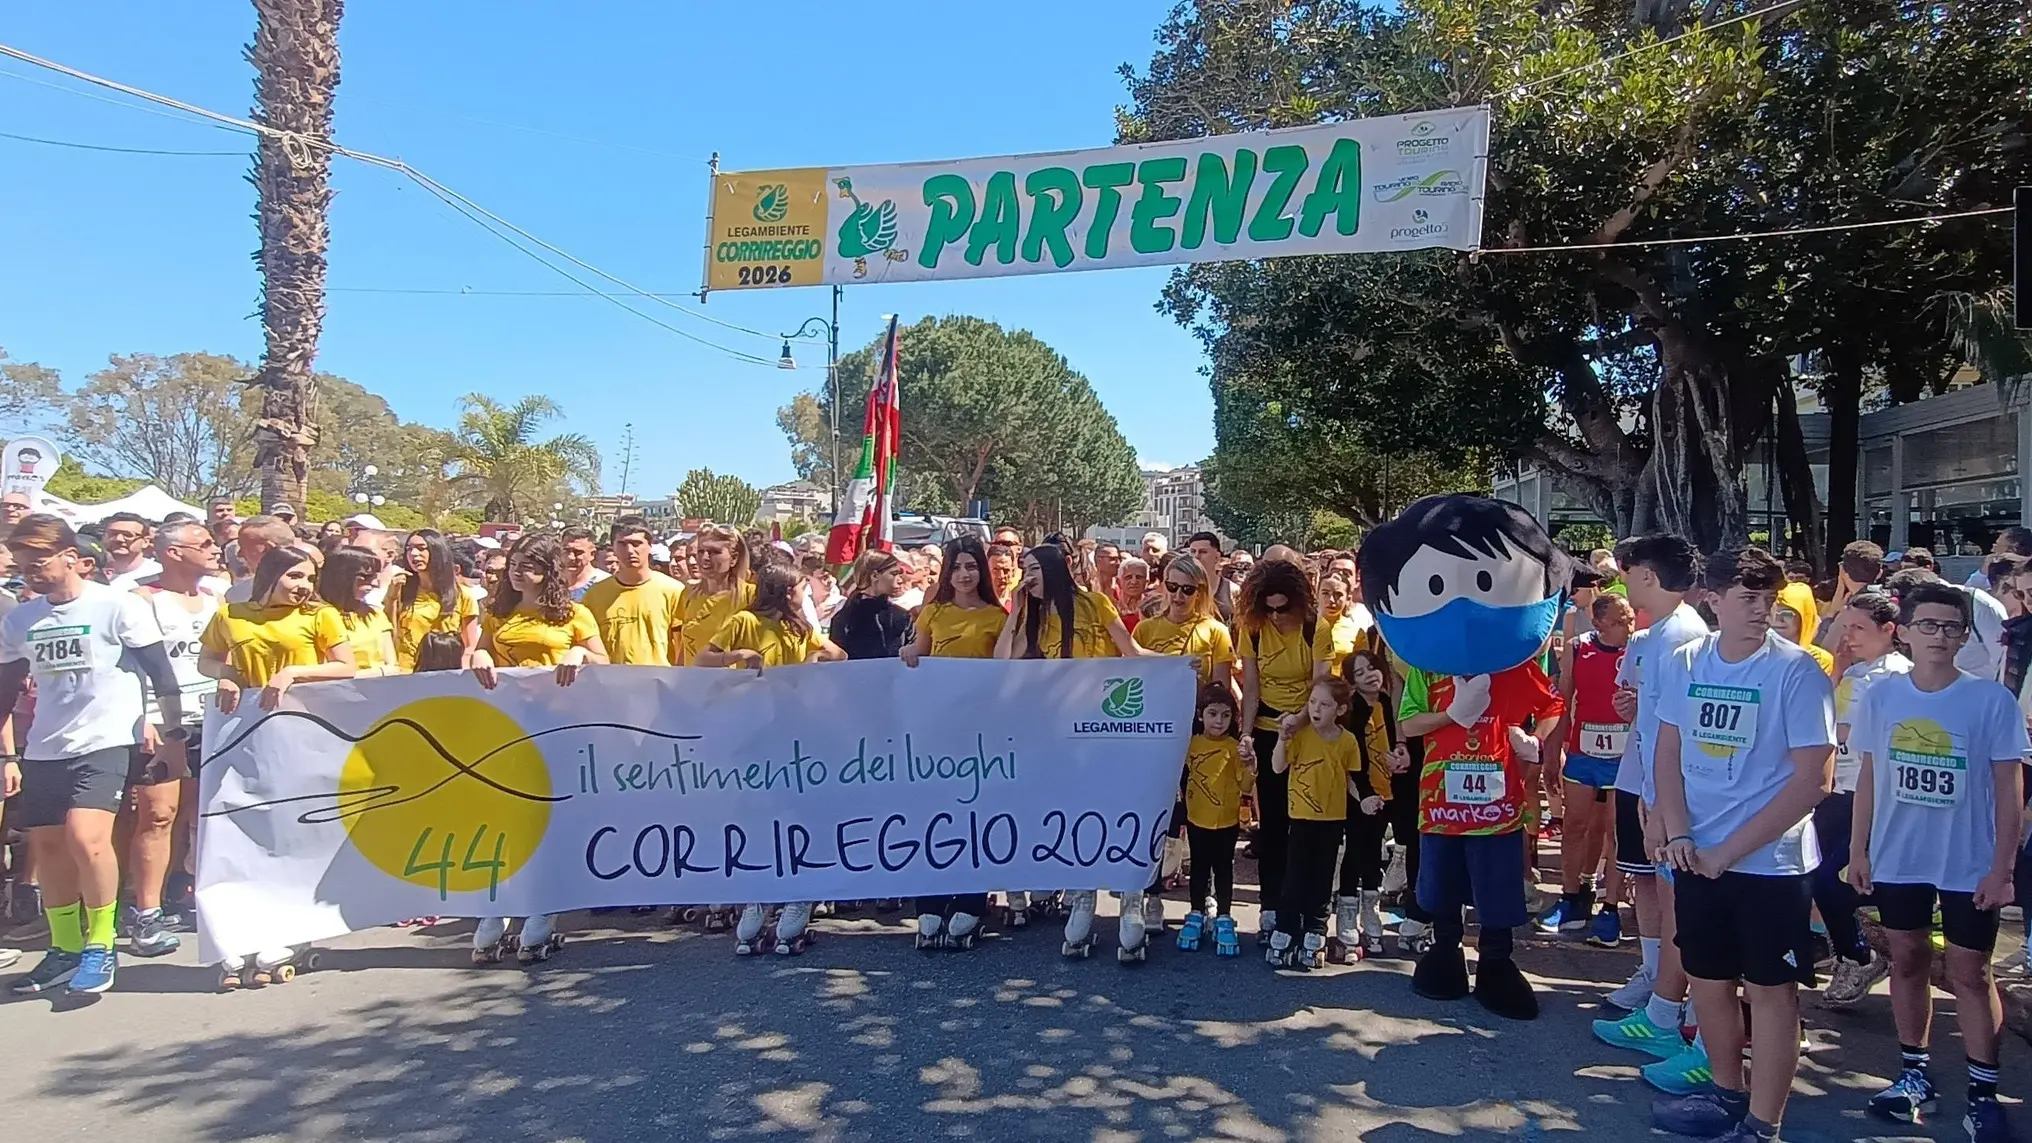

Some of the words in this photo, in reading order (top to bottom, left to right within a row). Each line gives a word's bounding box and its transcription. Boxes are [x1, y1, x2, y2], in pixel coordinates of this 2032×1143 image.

[1396, 138, 1449, 148] PROGETTO
[918, 138, 1362, 268] PARTENZA
[727, 225, 810, 238] LEGAMBIENTE
[716, 238, 822, 262] CORRIREGGIO
[738, 265, 792, 285] 2026
[35, 638, 84, 662] 2184
[1695, 687, 1753, 701] CORRIREGGIO
[1073, 722, 1174, 733] LEGAMBIENTE
[1699, 702, 1742, 730] 807
[1595, 733, 1613, 750] 41
[579, 744, 598, 794] il
[612, 740, 828, 797] sentimento
[839, 737, 895, 786] dei
[906, 735, 1017, 803] luoghi
[1896, 765, 1955, 795] 1893
[1463, 774, 1487, 793] 44
[585, 810, 1019, 880] CORRIREGGIO
[1031, 808, 1167, 869] 2026
[404, 824, 506, 902] 44
